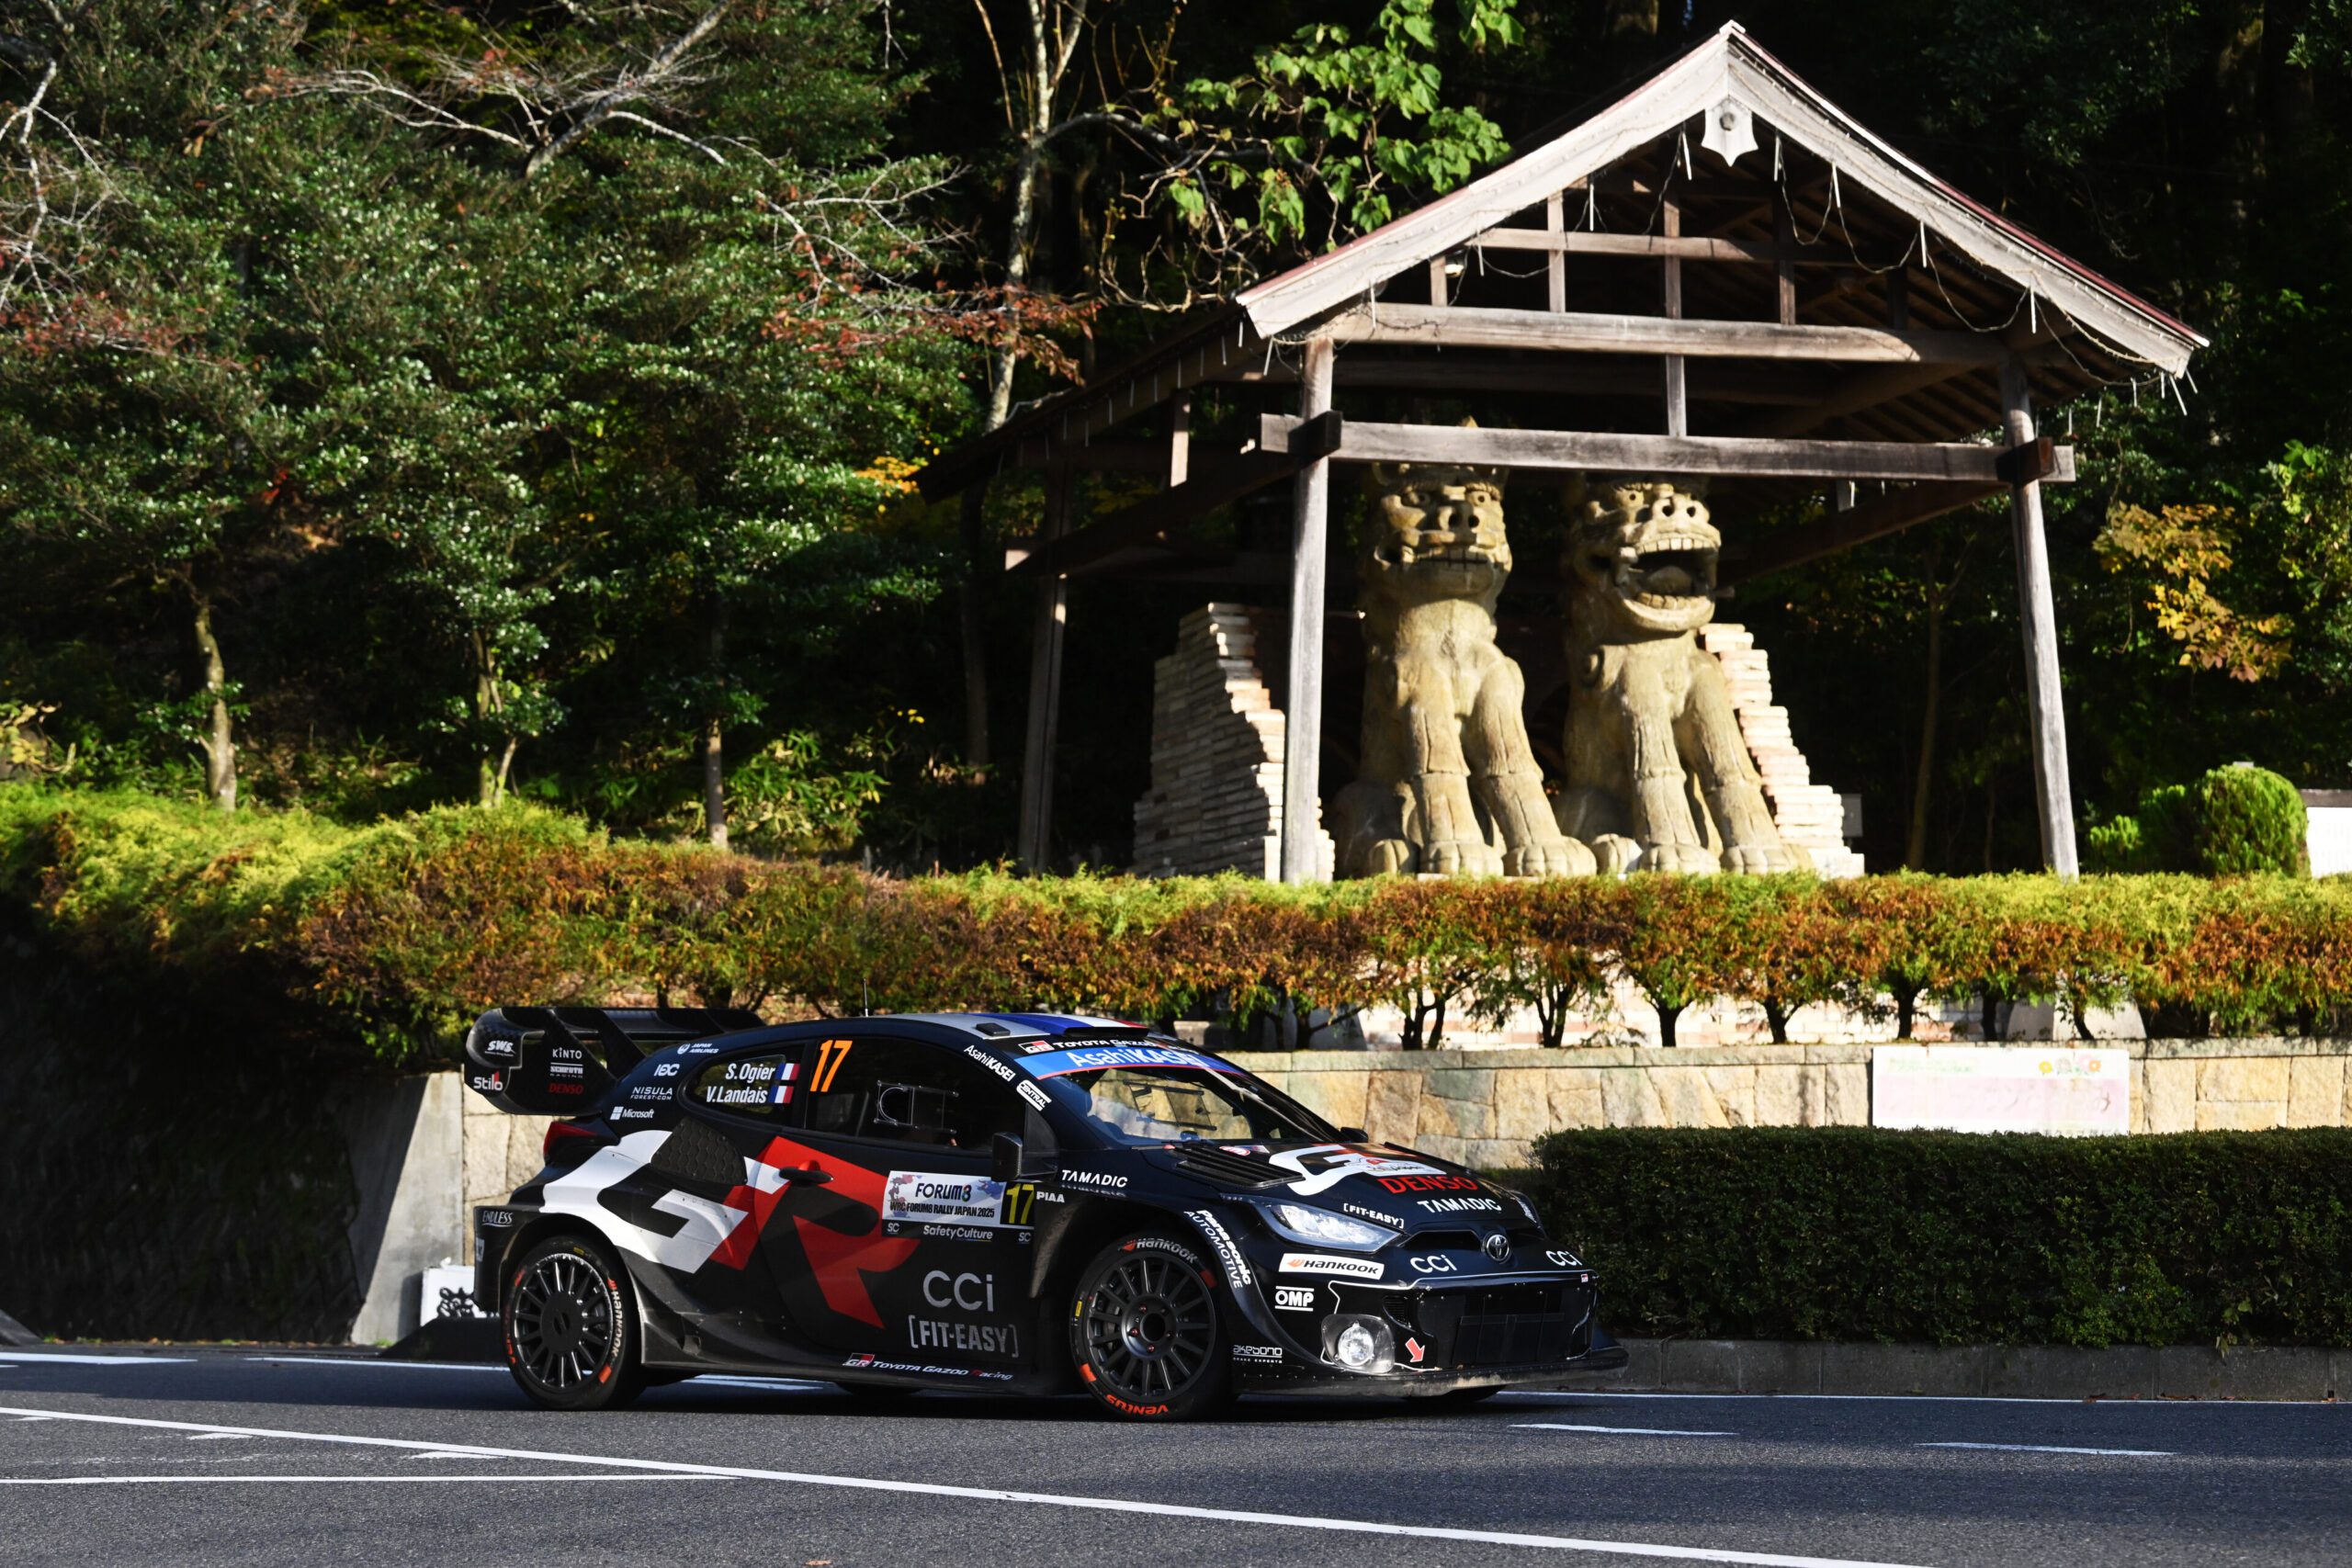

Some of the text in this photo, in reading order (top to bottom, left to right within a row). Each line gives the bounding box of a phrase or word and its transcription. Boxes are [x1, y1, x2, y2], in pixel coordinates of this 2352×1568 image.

[1052, 1040, 1109, 1049] TOYOTA
[809, 1040, 854, 1092] 17
[964, 1044, 1016, 1082] AsahiKASEI
[473, 1073, 503, 1091] Stilo
[725, 1063, 776, 1084] S.Ogier
[548, 1084, 584, 1095] DENSO
[632, 1087, 673, 1095] NISULA
[706, 1086, 769, 1103] V.Landais
[1020, 1082, 1047, 1108] CENTRAL
[622, 1109, 654, 1118] Microsoft
[1061, 1169, 1128, 1188] TAMADIC
[1377, 1176, 1478, 1194] DENSO
[915, 1183, 972, 1202] FORUM8
[1036, 1190, 1065, 1203] PIAA
[890, 1201, 995, 1218] WRC FORUM8 RALLY JAPAN 2025
[1006, 1184, 1035, 1224] 17
[1417, 1197, 1502, 1213] TAMADIC
[482, 1212, 513, 1224] ENDLESS
[887, 1223, 900, 1234] SC
[923, 1224, 993, 1240] SafetyCulture
[1018, 1231, 1032, 1242] SC
[1182, 1211, 1243, 1289] AUTOMOTIVE
[1196, 1210, 1251, 1285] Panasonic
[1275, 1290, 1314, 1307] OMP
[872, 1361, 921, 1371] TOYOTA
[922, 1365, 968, 1376] GAZOO
[969, 1369, 1013, 1382] Racing
